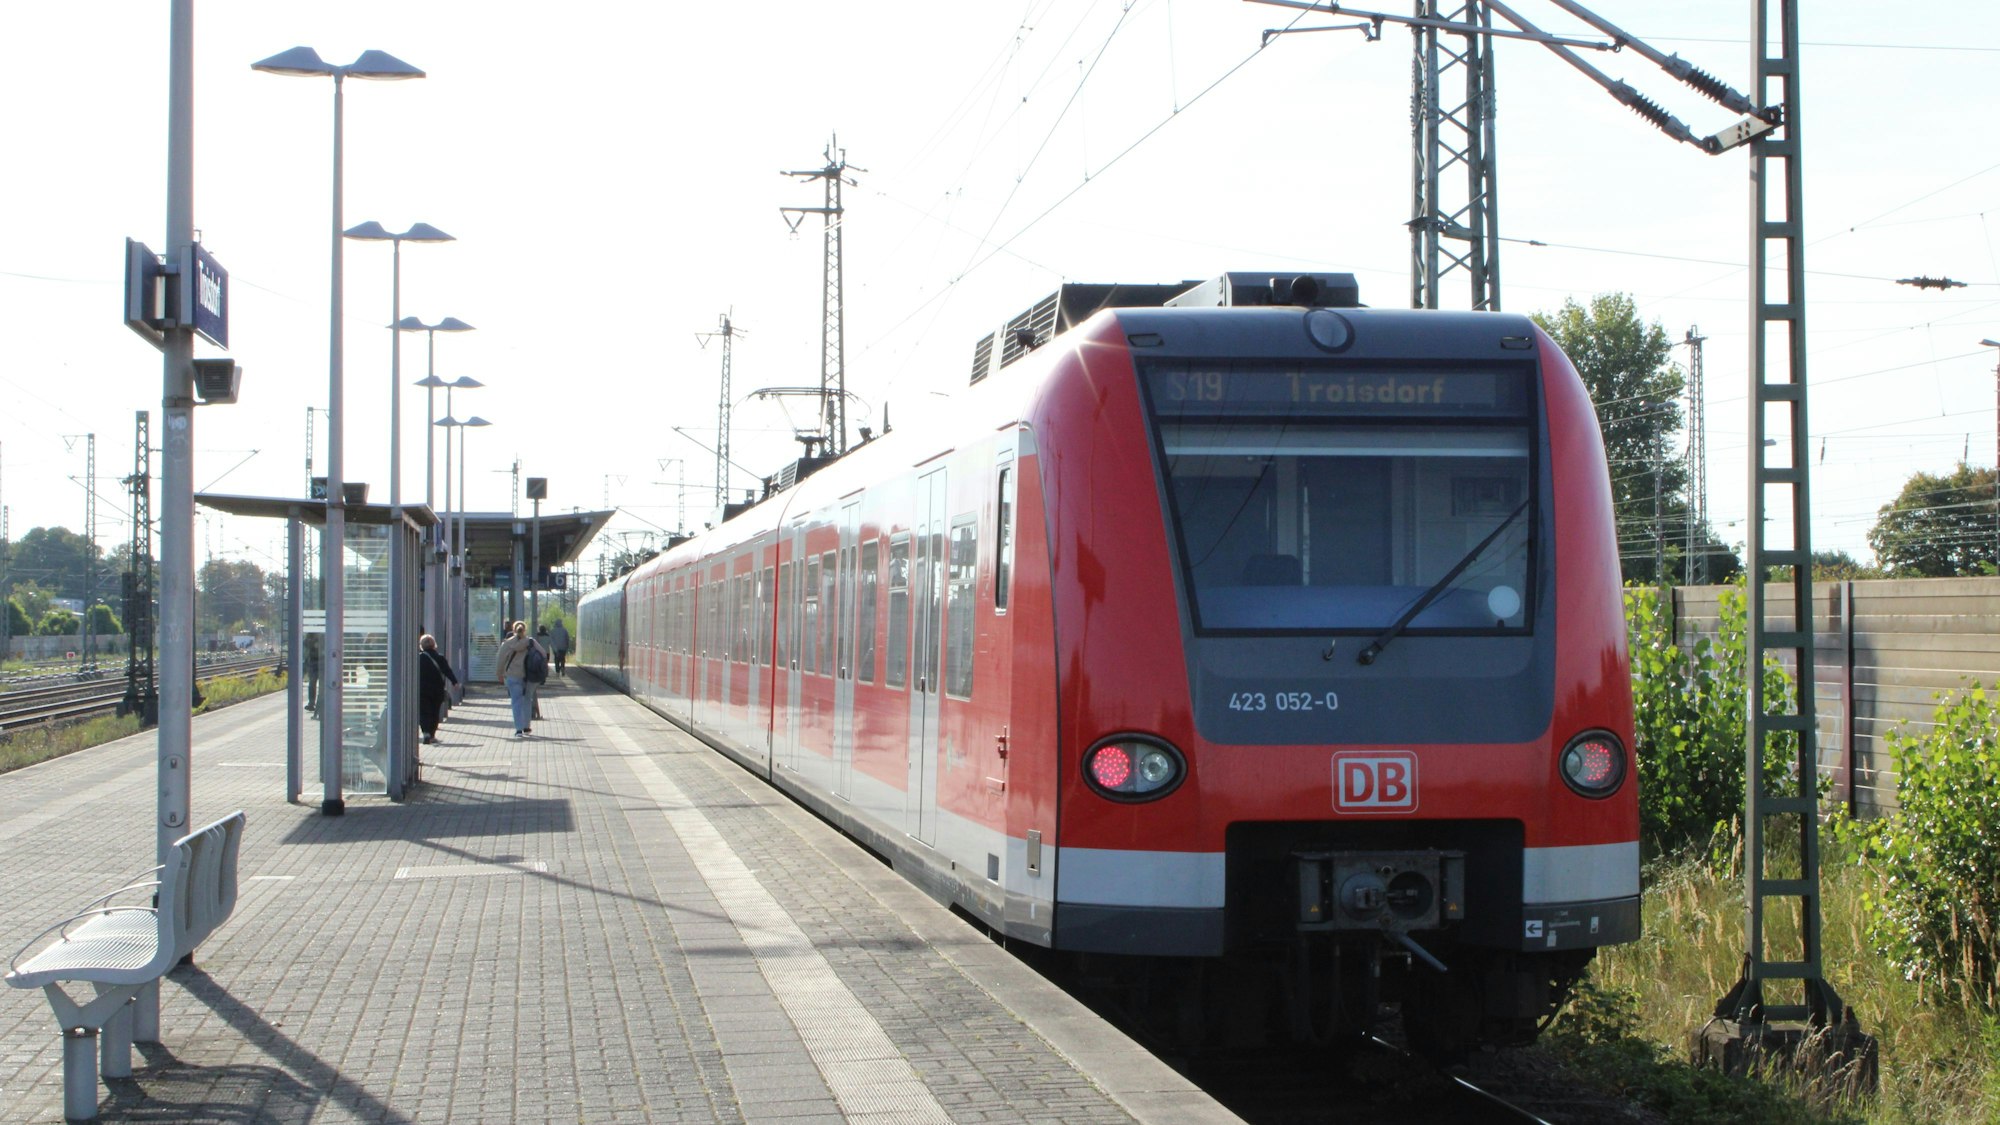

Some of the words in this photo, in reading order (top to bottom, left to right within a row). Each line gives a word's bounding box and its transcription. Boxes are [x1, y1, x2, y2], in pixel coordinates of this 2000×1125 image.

[1168, 371, 1223, 401] S19
[1286, 371, 1445, 403] Troisdorf
[555, 573, 565, 587] 6
[1228, 692, 1267, 711] 423
[1275, 692, 1339, 711] 052-0
[1343, 762, 1408, 803] DB
